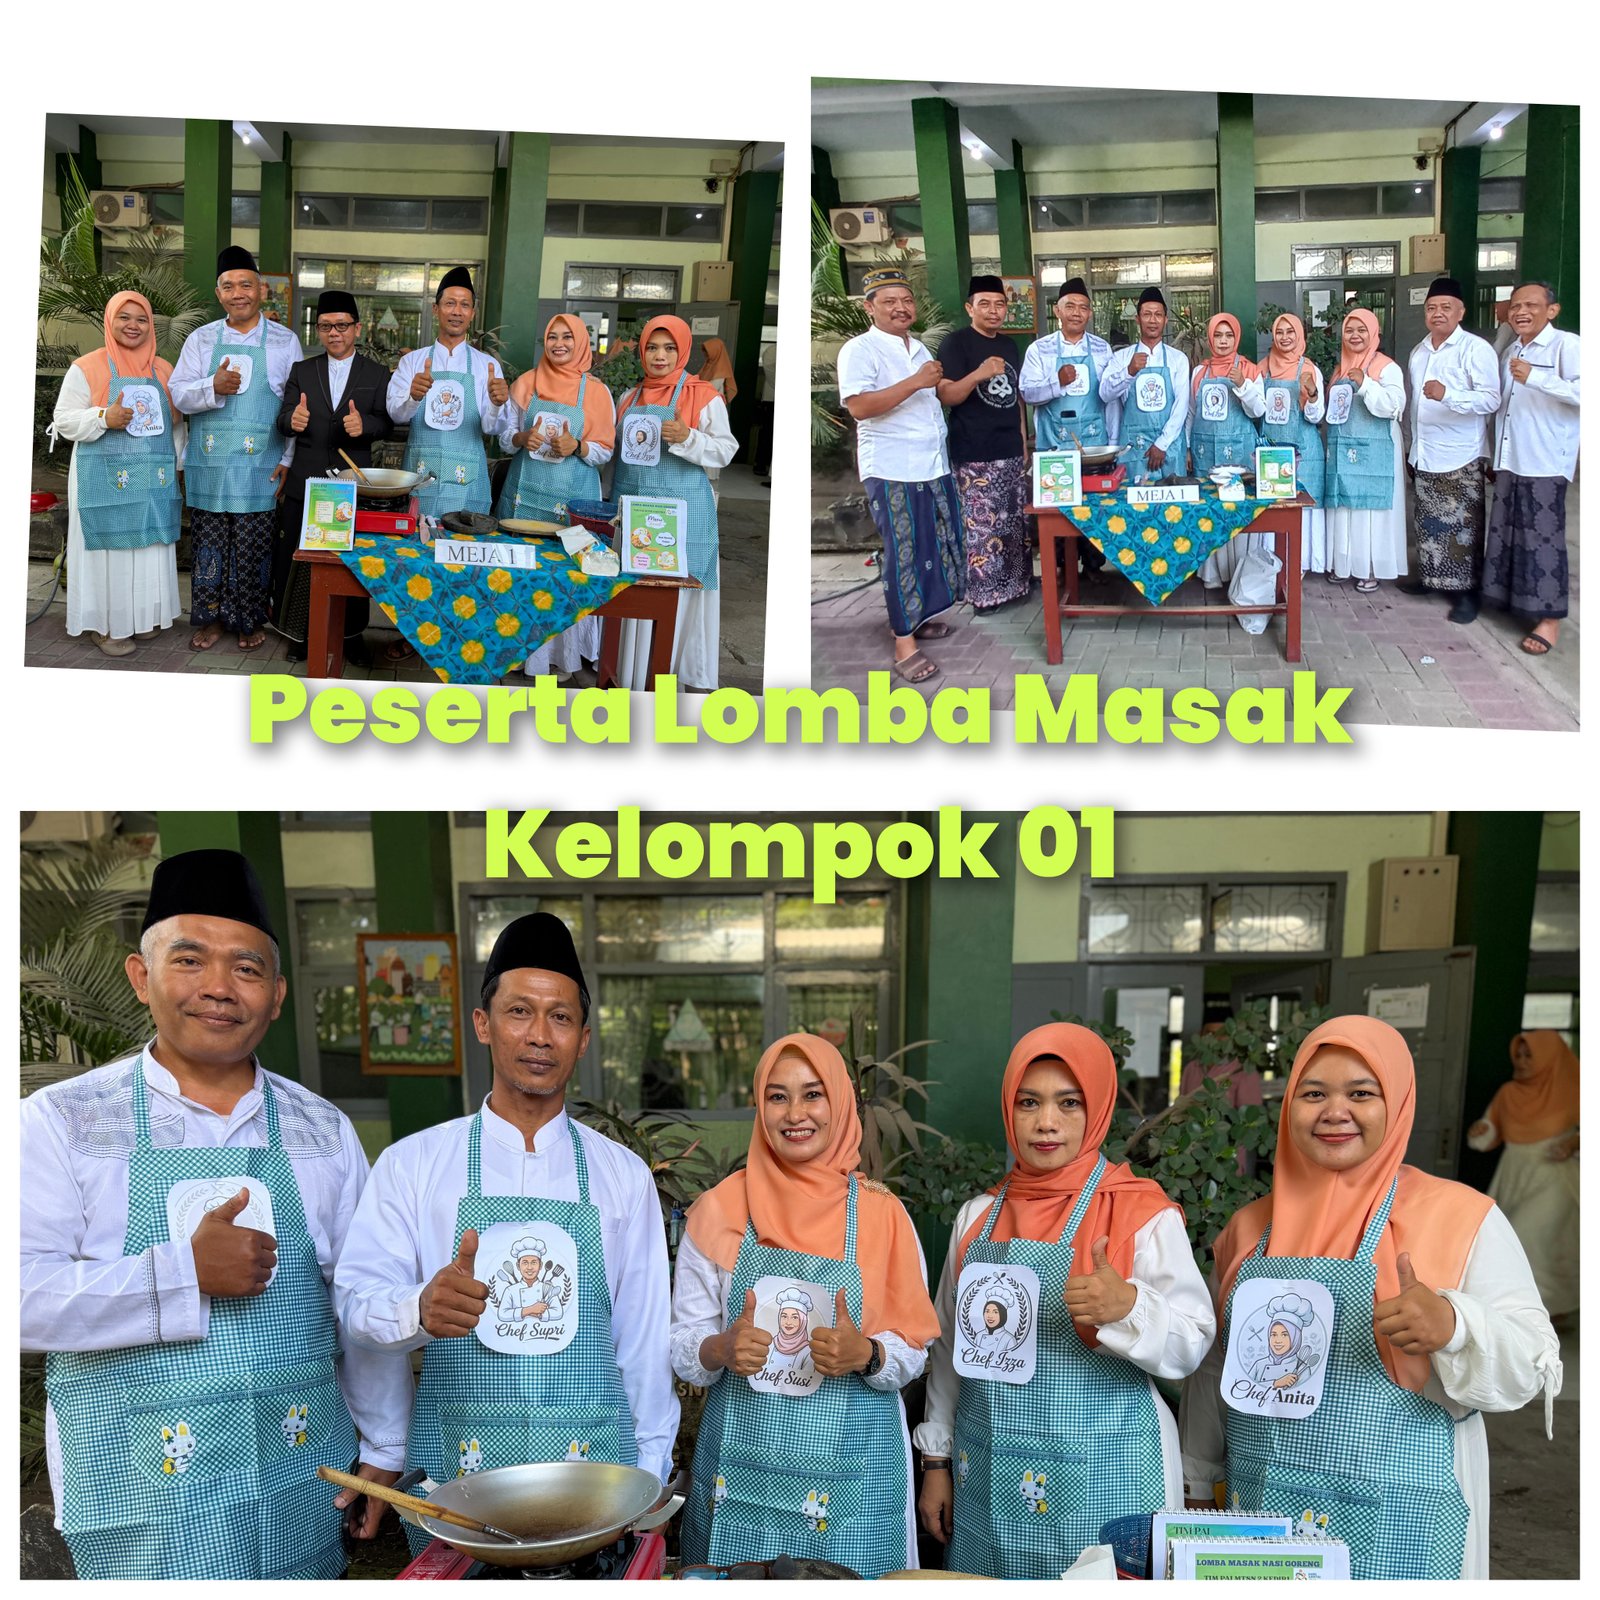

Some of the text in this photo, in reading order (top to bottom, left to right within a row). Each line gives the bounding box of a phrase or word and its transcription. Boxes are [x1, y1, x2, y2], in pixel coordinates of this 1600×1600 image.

[1136, 488, 1185, 502] MEJA 1
[447, 545, 516, 565] MEJA 1
[494, 1322, 566, 1341] Chef Supri
[961, 1347, 1026, 1373] Chef Izza
[784, 1370, 813, 1387] Susi
[1230, 1378, 1315, 1407] Chef Anita
[1173, 1525, 1211, 1536] TIM PAI
[1228, 1559, 1260, 1567] MASAK
[1285, 1560, 1320, 1568] GORENG
